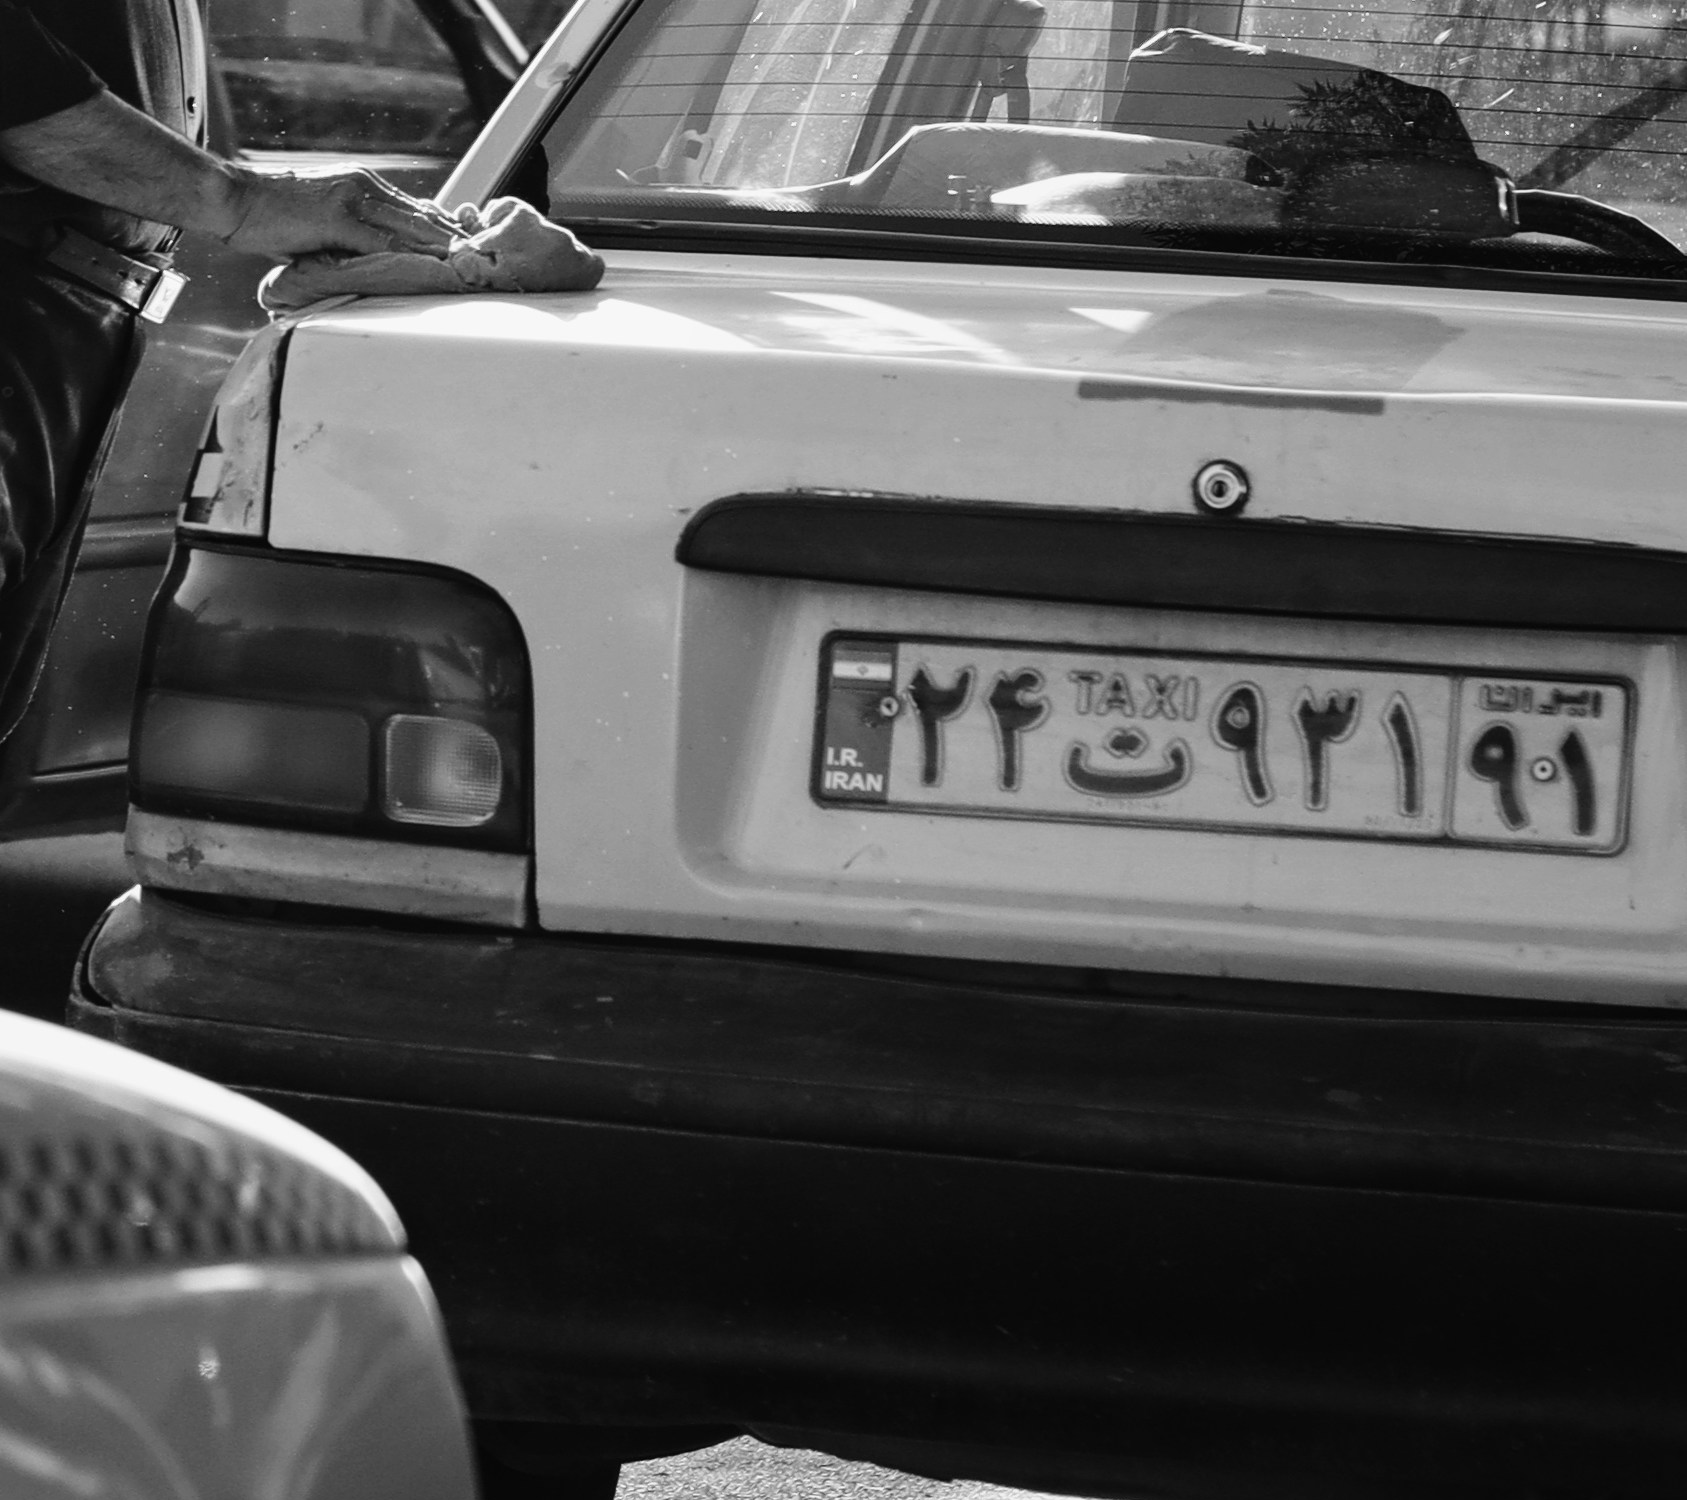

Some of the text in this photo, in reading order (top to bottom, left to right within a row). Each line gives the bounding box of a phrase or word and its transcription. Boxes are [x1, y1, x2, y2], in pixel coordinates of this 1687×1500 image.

[1067, 669, 1200, 721] TAXI
[1480, 684, 1604, 718] ایران
[826, 746, 864, 768] I.R.
[824, 769, 885, 793] IRAN
[1467, 721, 1596, 836] ۹۱
